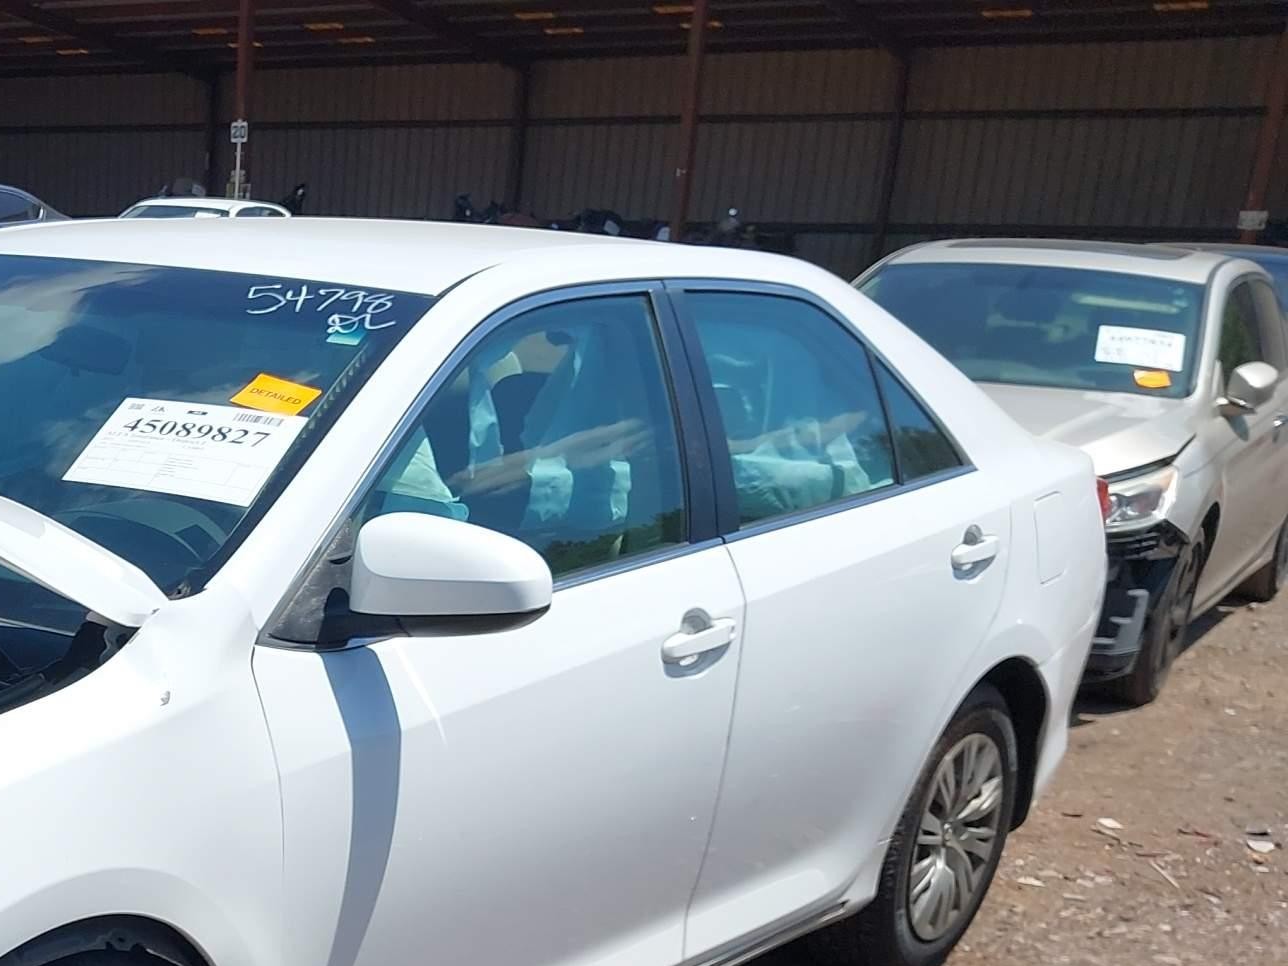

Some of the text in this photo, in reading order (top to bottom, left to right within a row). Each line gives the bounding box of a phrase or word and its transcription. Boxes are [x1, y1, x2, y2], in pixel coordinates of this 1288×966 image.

[246, 284, 395, 315] 54798
[249, 387, 302, 406] DETAILED
[122, 417, 272, 448] 45089827
